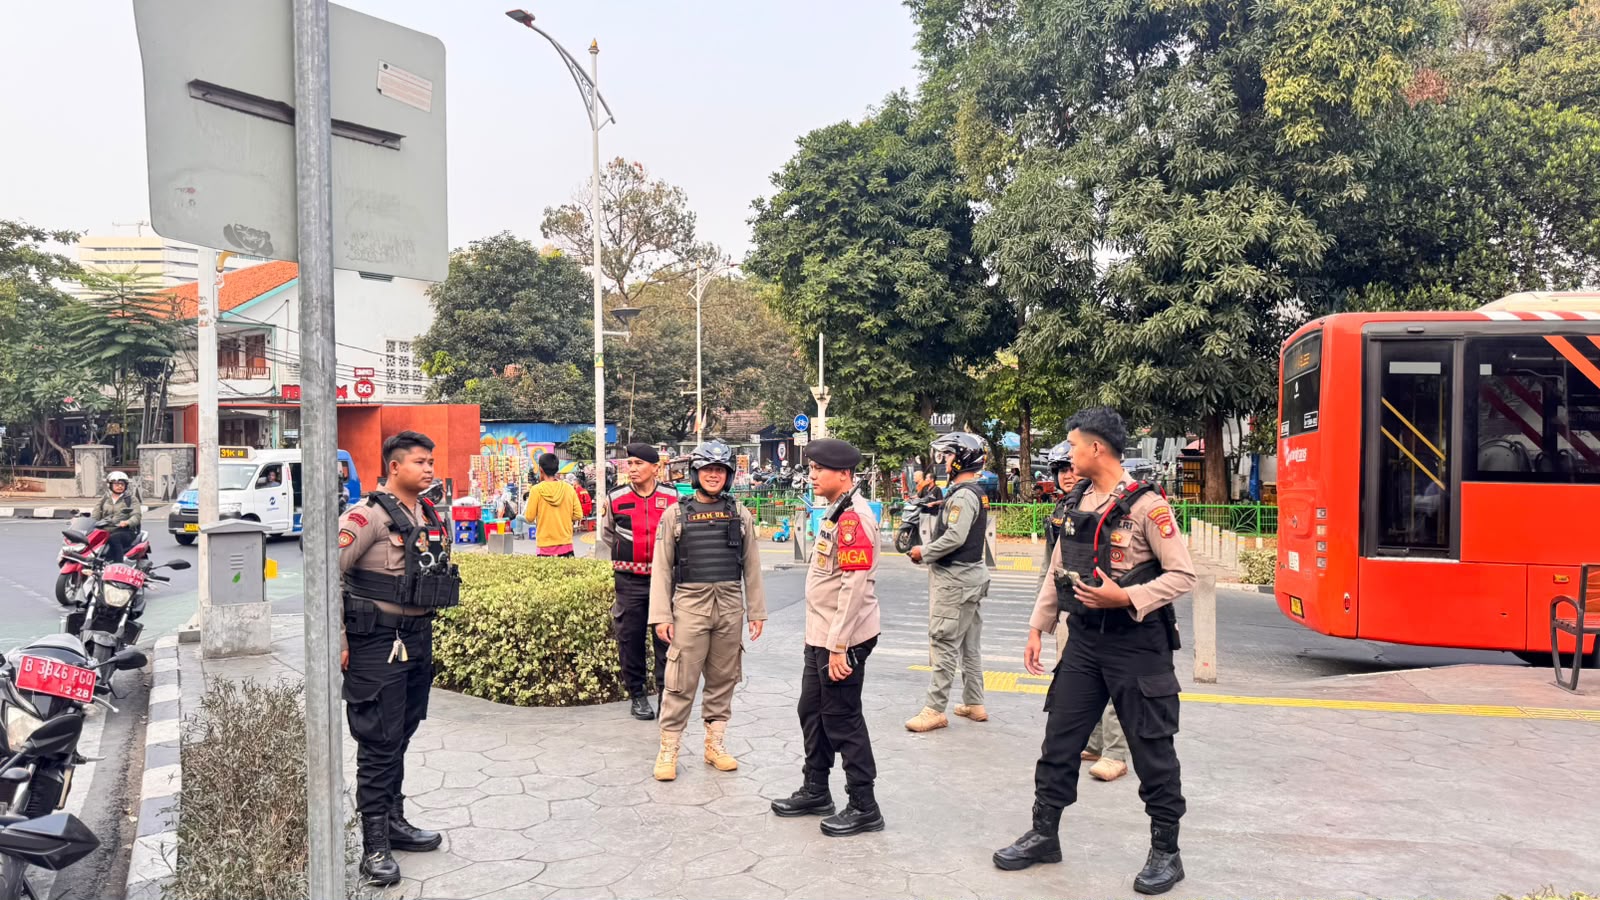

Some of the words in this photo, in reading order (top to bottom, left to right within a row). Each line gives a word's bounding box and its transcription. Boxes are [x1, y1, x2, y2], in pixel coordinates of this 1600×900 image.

[358, 384, 372, 394] 5G
[1118, 520, 1134, 530] LRI
[25, 659, 34, 673] B
